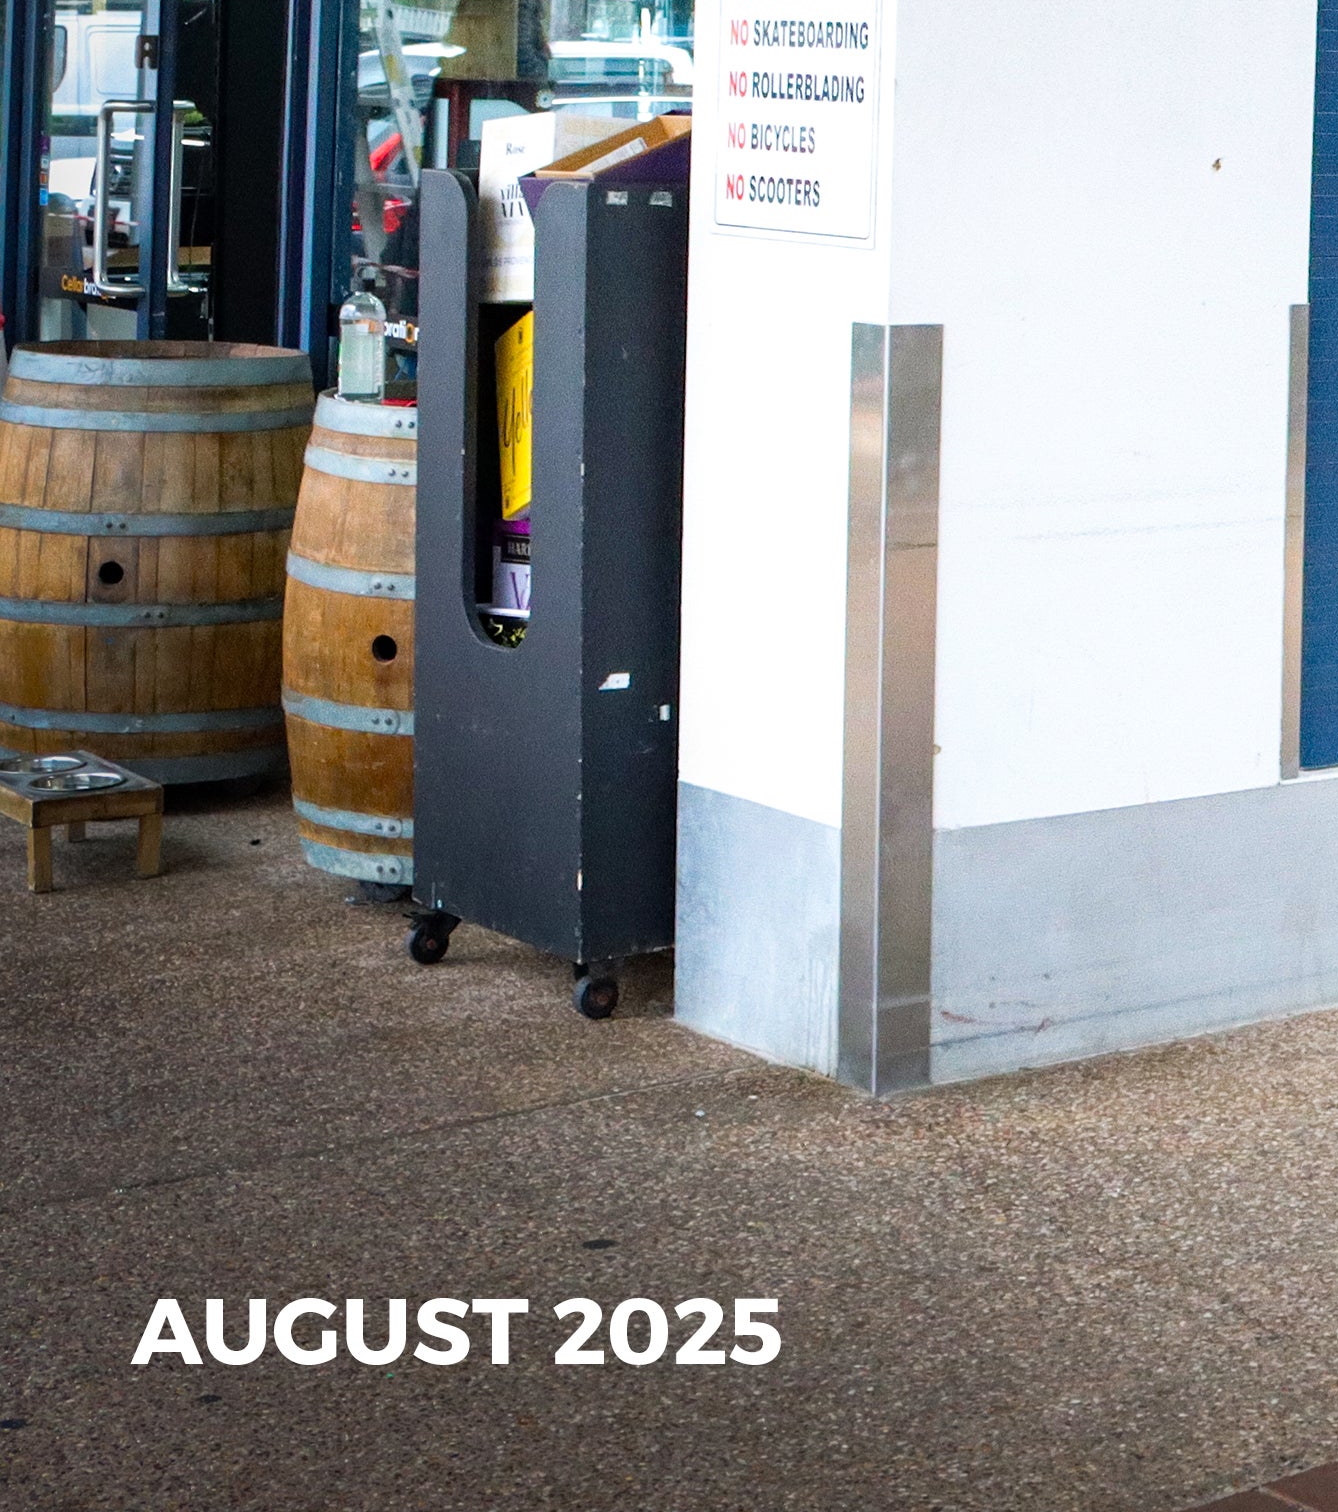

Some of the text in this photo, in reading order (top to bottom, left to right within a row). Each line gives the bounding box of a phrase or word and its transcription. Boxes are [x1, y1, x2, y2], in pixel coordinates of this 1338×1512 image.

[730, 20, 869, 49] NO SKATEBOARDING
[729, 72, 865, 103] NO ROLLERBLADING
[727, 123, 816, 154] NO BICYCLES
[726, 174, 820, 207] NO SCOOTERS
